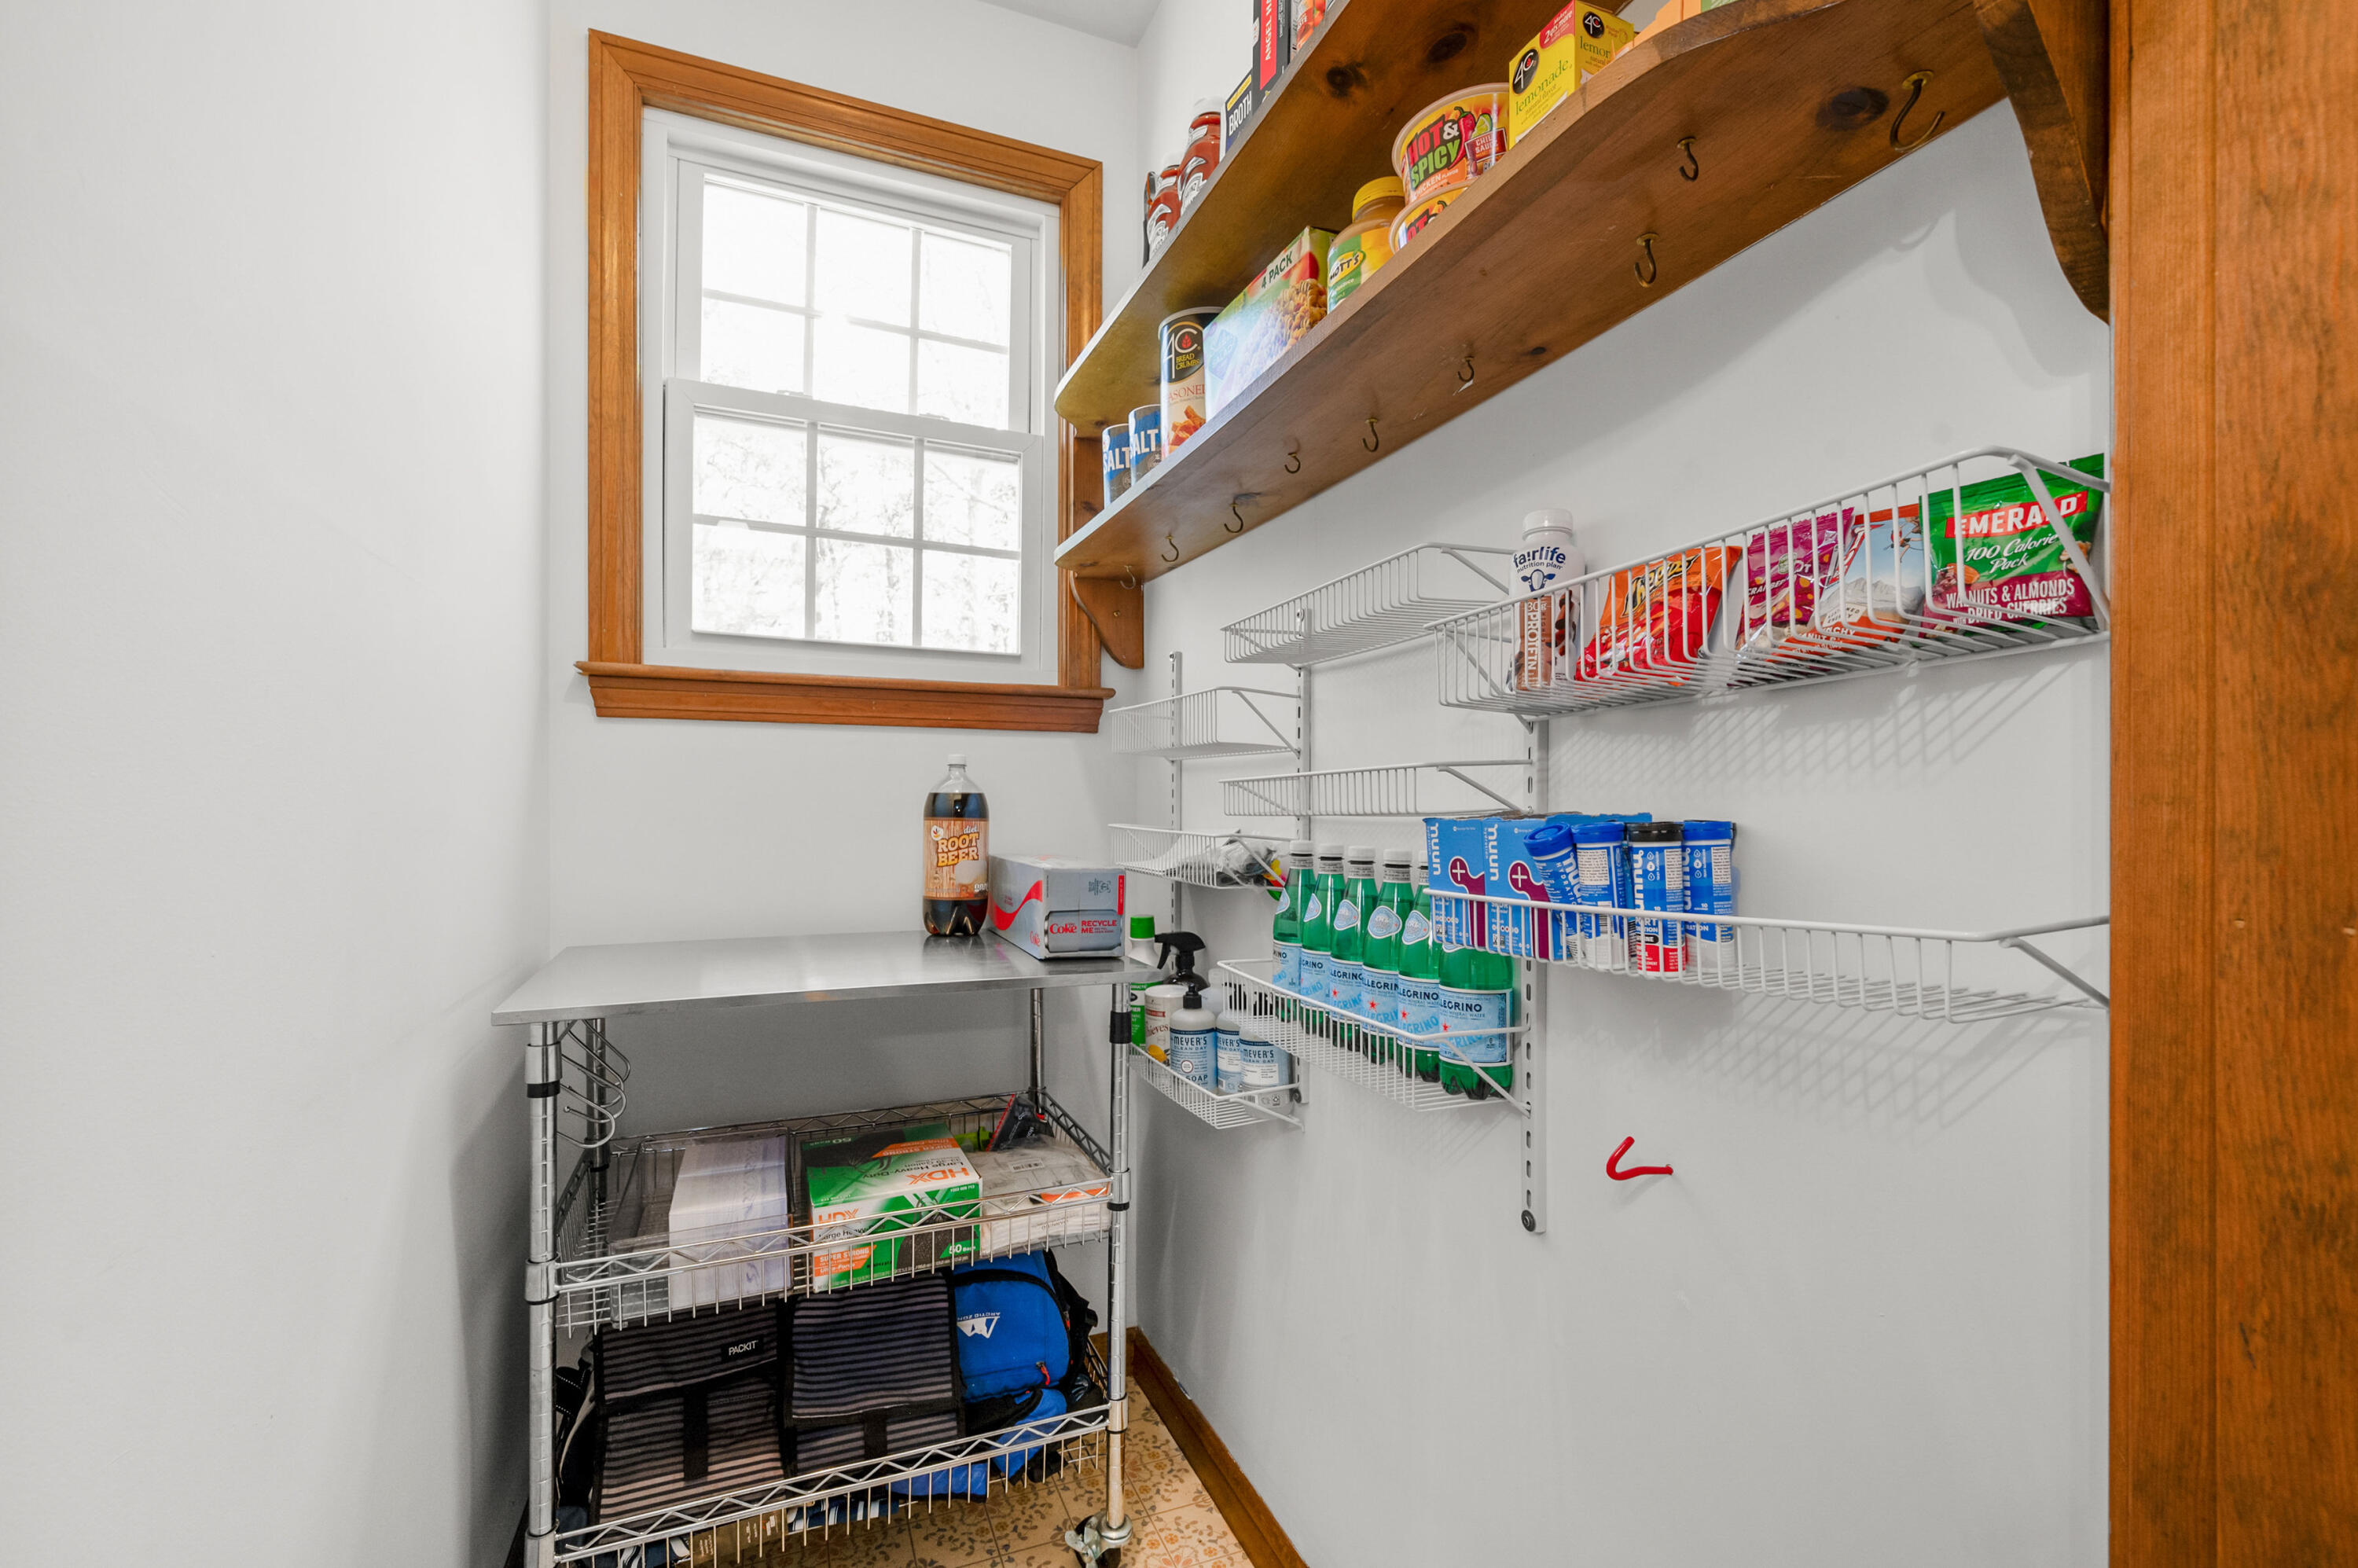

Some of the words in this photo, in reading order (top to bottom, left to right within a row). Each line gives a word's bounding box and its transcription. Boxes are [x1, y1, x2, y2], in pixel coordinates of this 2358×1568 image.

[1585, 15, 1601, 35] 4C
[1514, 52, 1534, 89] 4C
[1515, 60, 1569, 116] lemonade
[1229, 90, 1252, 137] BROTH
[1409, 119, 1443, 167] HOT
[1443, 121, 1460, 141] &
[1475, 134, 1495, 147] CHIL
[1475, 142, 1498, 154] SAU
[1412, 138, 1460, 189] SPICY
[1407, 214, 1428, 241] OT
[1262, 276, 1267, 288] 4
[1269, 251, 1293, 284] PACK
[1330, 254, 1360, 281] MOTT'S
[1164, 328, 1199, 379] 4C
[1176, 353, 1195, 364] BREAD
[1176, 359, 1200, 370] CRUMBS
[1954, 495, 2077, 536] EMERAD
[1966, 545, 2000, 562] 100
[2003, 533, 2060, 557] Calorie
[1517, 561, 1544, 574] nutrition
[1546, 561, 1563, 571] plan
[1989, 553, 2029, 575] Pack
[1622, 553, 1699, 619] Cheeos
[1748, 579, 1791, 597] CRABER
[2002, 586, 2011, 602] &
[2014, 578, 2076, 600] ALMONDS
[964, 825, 978, 834] diet
[938, 832, 980, 852] ROOT
[1430, 822, 1442, 876] nuun
[1488, 823, 1500, 881] nuun
[937, 846, 979, 867] BEER
[1049, 923, 1077, 935] Coke
[1173, 1036, 1207, 1046] MEYER'S
[1243, 1048, 1274, 1059] MEYER'S
[882, 1148, 920, 1156] STRONG
[862, 1166, 929, 1179] Heavy-Duty
[907, 1167, 970, 1185] HDX
[818, 1208, 859, 1225] HDX
[819, 1231, 841, 1240] arge
[729, 1339, 757, 1356] PACKIT
